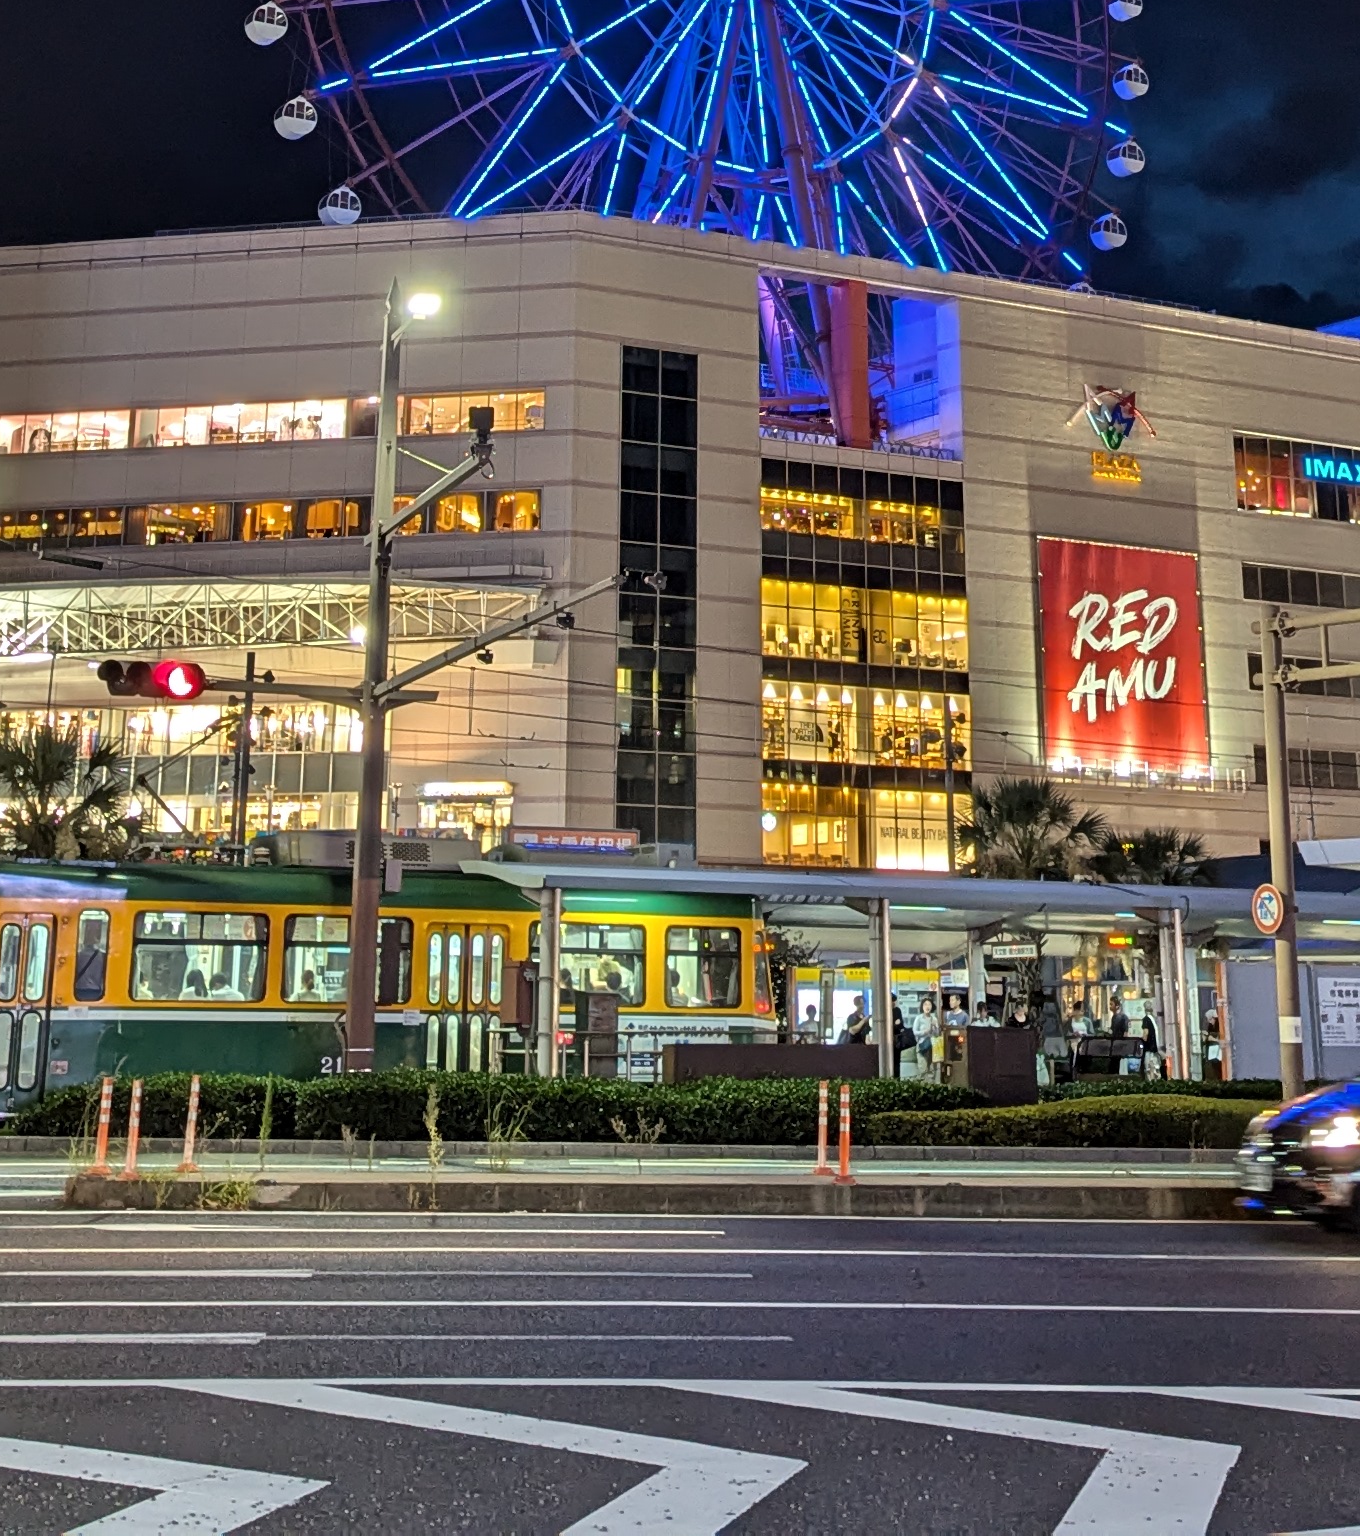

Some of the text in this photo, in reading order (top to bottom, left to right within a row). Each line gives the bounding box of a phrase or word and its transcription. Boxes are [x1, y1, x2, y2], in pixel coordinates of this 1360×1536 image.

[1068, 589, 1179, 660] RED
[1067, 656, 1177, 723] AMU
[880, 826, 909, 839] NATURAL
[911, 827, 937, 840] BEAUTY
